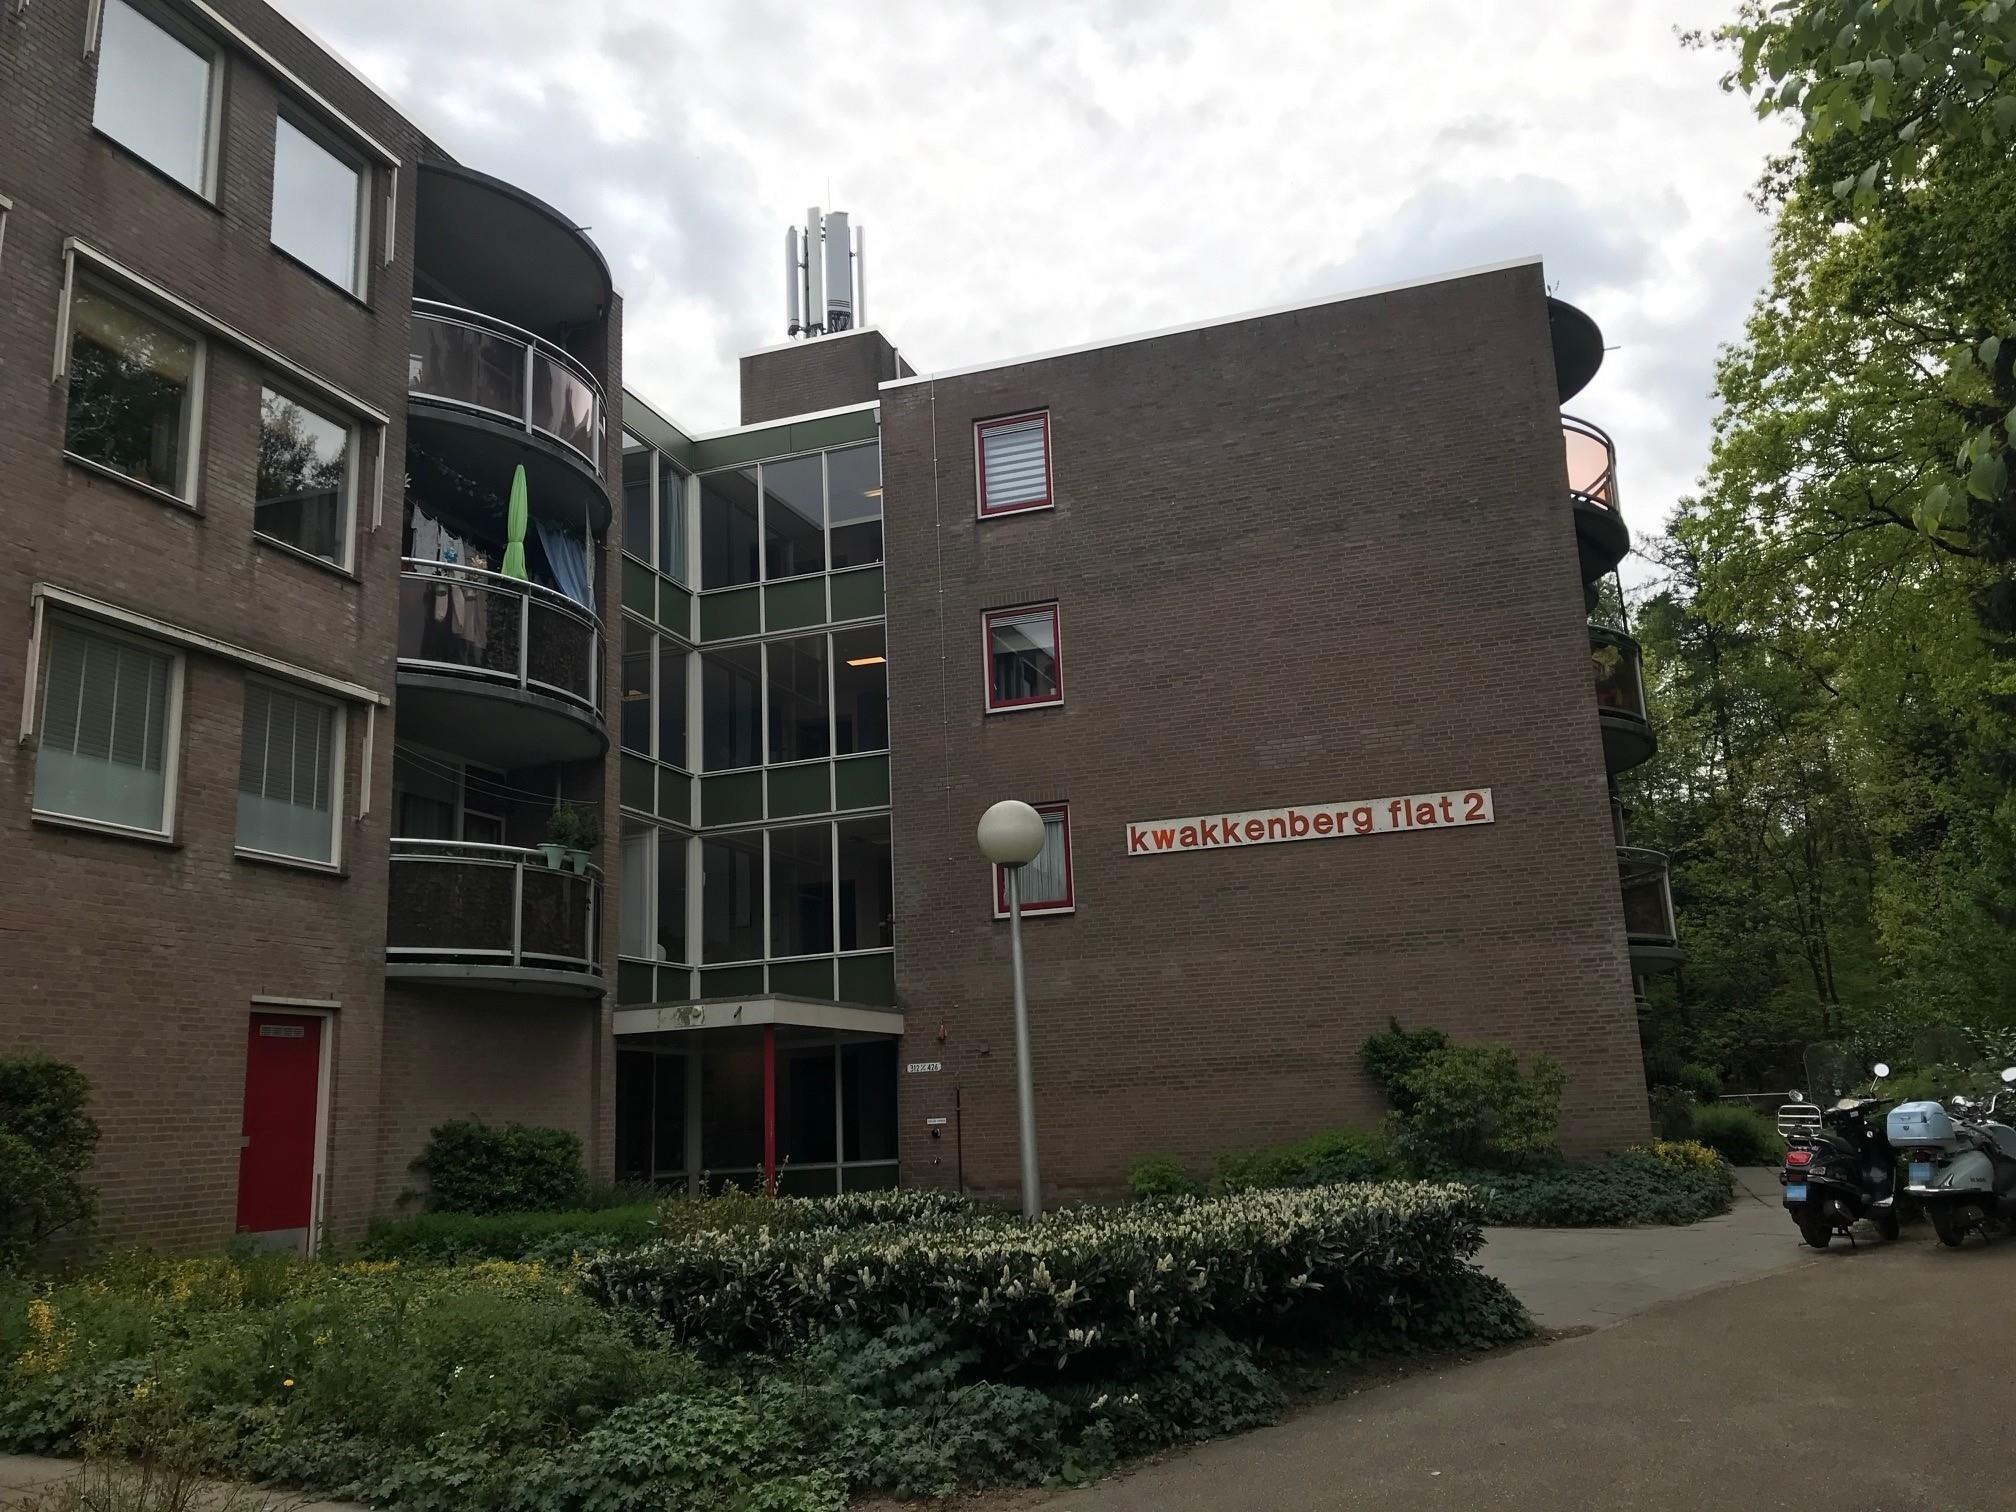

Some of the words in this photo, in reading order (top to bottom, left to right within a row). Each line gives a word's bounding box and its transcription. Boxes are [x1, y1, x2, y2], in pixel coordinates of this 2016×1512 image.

[1130, 806, 1373, 852] kwakkenberg
[1389, 796, 1454, 827] flat
[1463, 793, 1485, 821] 2
